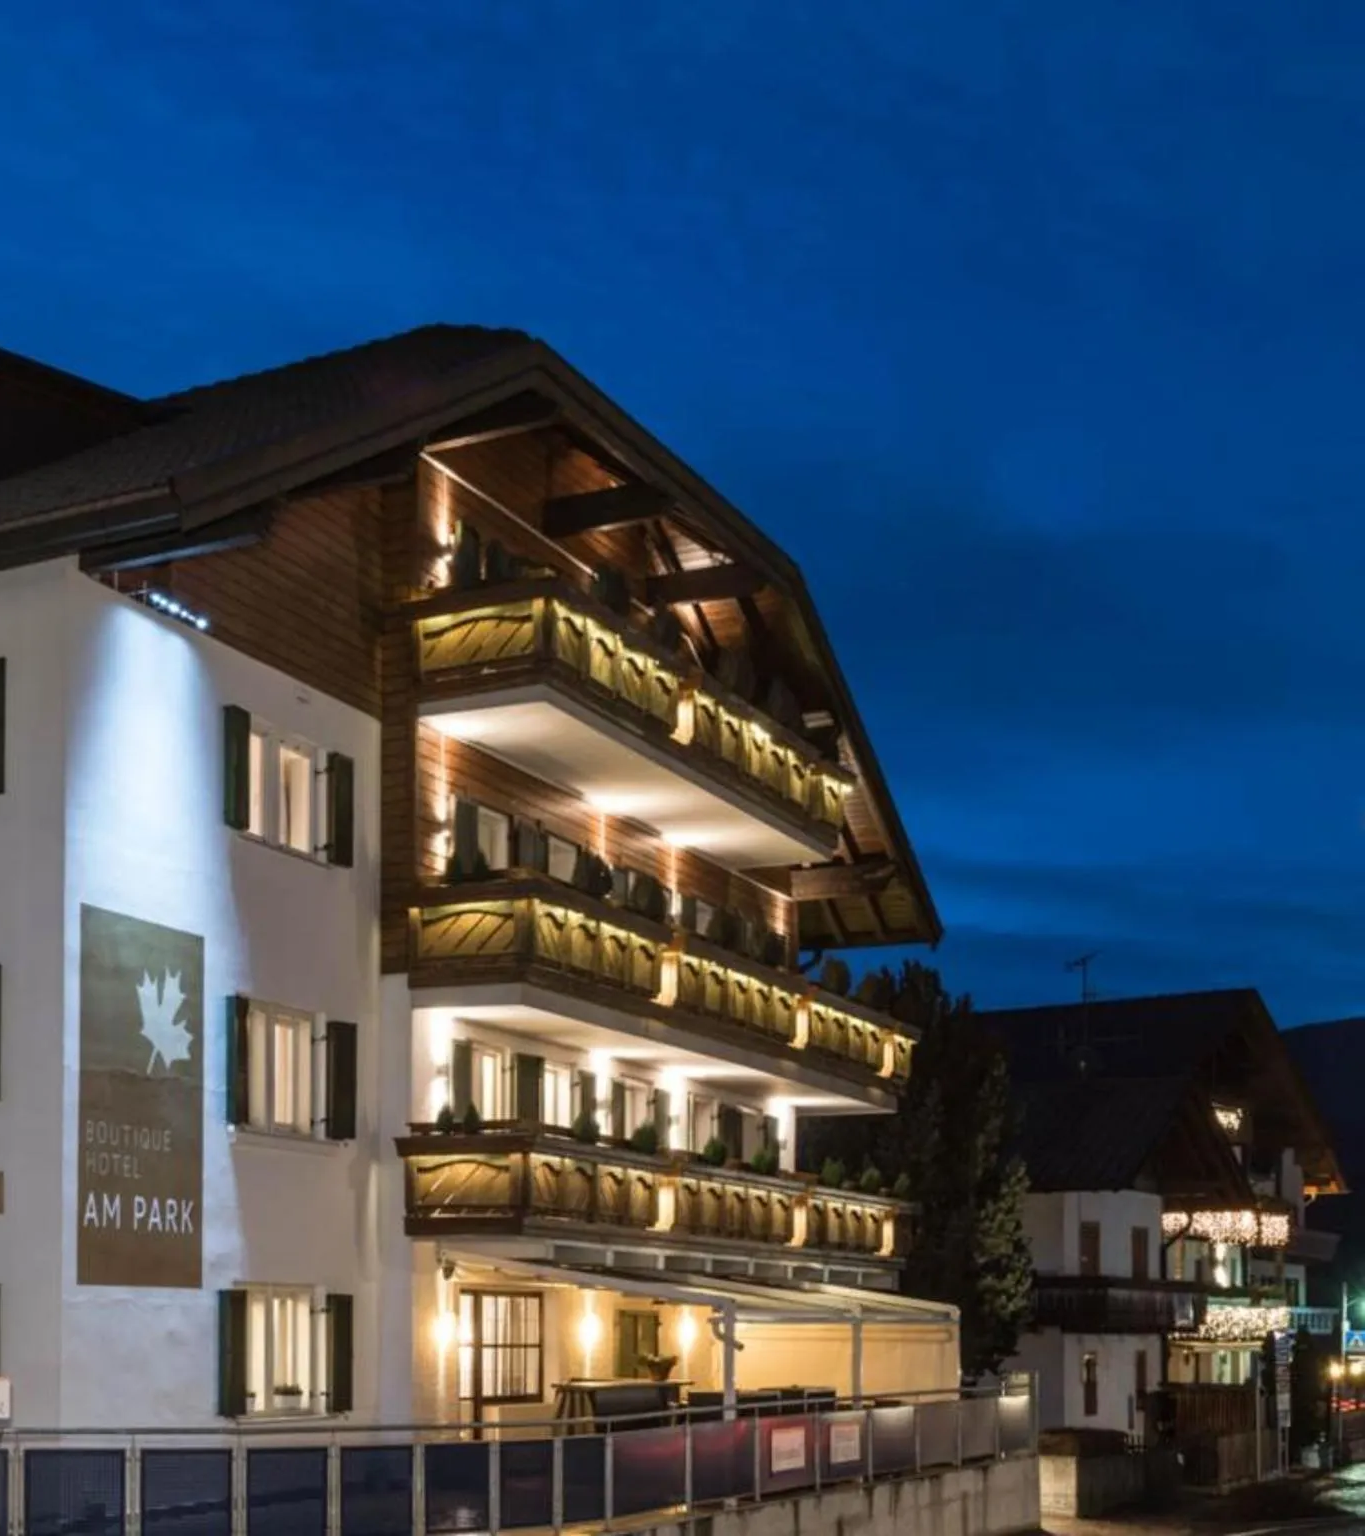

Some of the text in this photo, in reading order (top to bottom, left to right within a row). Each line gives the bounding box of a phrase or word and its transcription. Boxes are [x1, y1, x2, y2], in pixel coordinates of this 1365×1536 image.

[86, 1119, 172, 1152] BOUTIQUE
[86, 1151, 143, 1179] HOTEL
[83, 1191, 194, 1234] AM PARK
